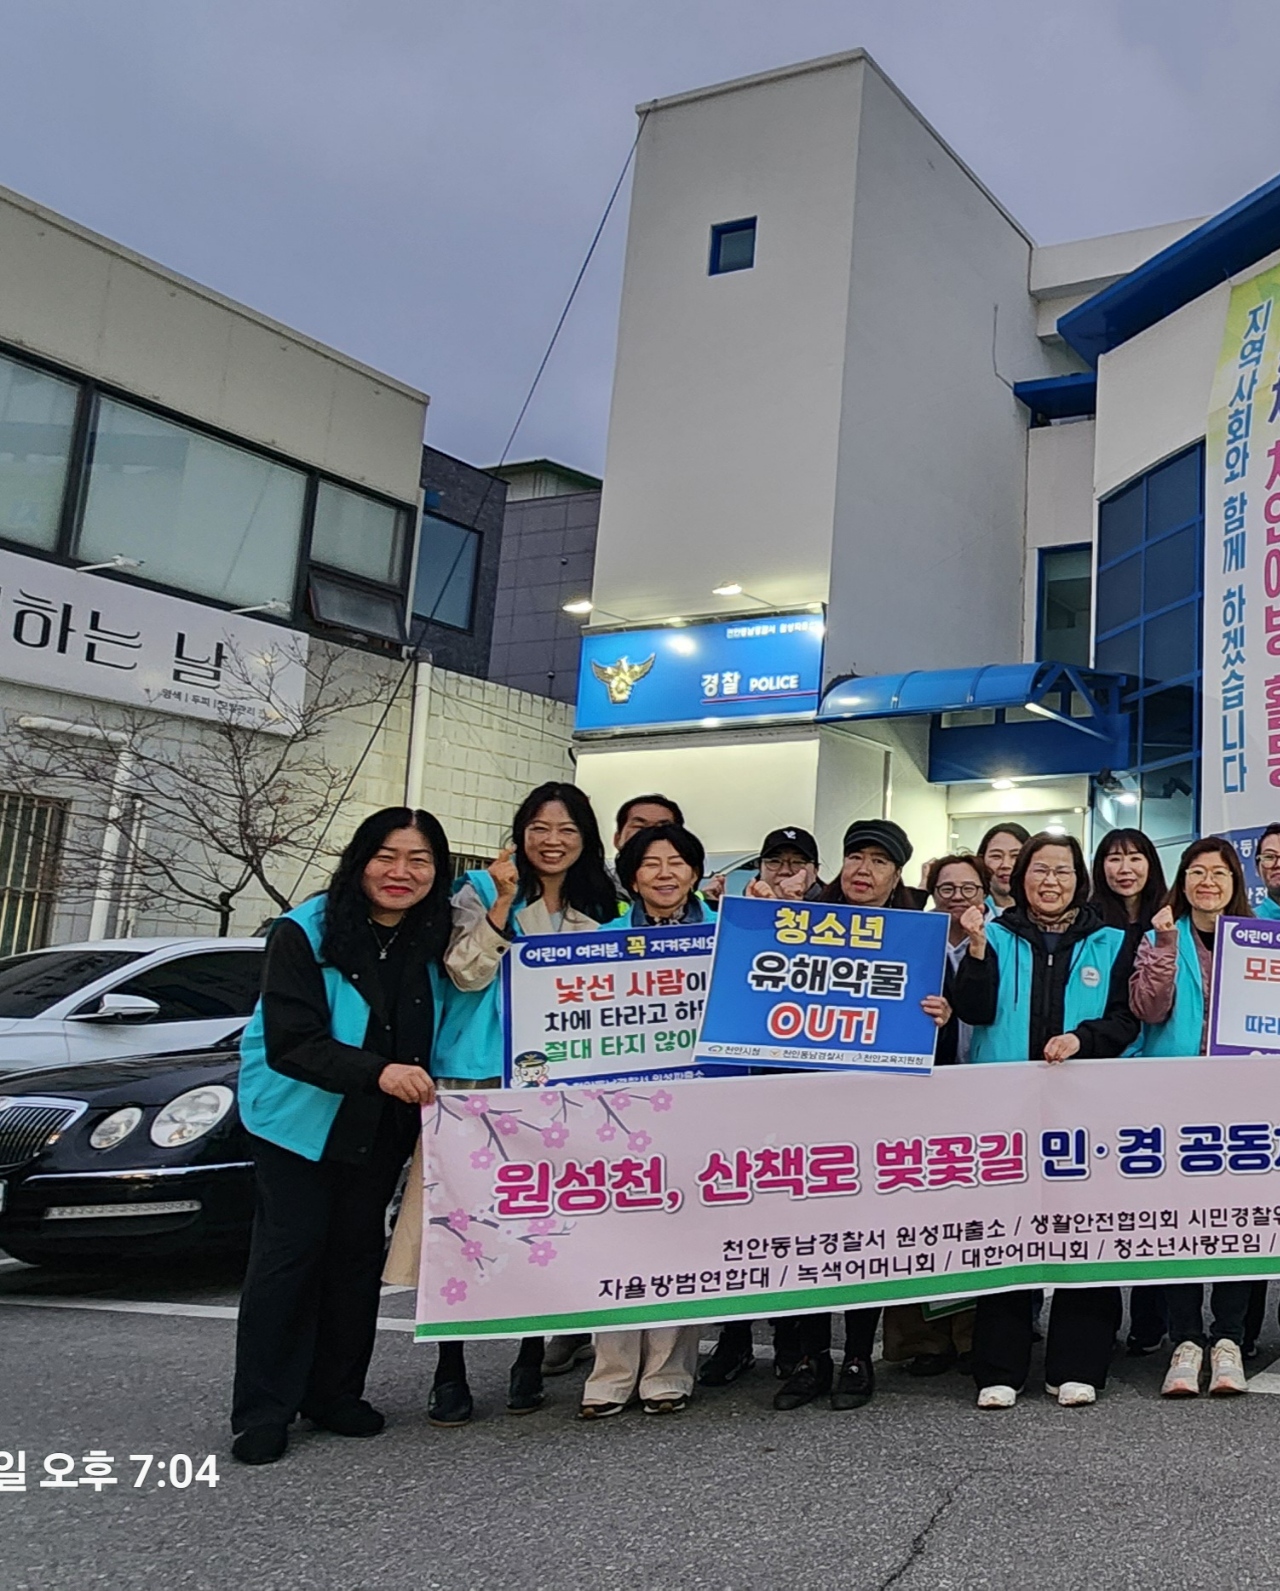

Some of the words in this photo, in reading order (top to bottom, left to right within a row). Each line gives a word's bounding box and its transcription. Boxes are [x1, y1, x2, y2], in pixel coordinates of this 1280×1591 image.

[1224, 299, 1272, 485] 지역사회와
[1222, 491, 1247, 575] 함께
[12, 588, 143, 671] 하는
[172, 631, 229, 690] 날
[701, 671, 740, 697] 경찰
[749, 674, 799, 692] POLICE
[1221, 584, 1247, 794] 하겠습니다
[525, 946, 572, 962] 어린이
[575, 942, 624, 959] 여러분,
[626, 935, 647, 957] 꼭
[775, 906, 885, 950] 청소년
[1235, 929, 1273, 944] 어린이
[555, 973, 616, 1005] 낯선
[626, 968, 707, 998] 사람이
[748, 951, 908, 1000] 유해약물
[544, 1009, 592, 1033] 차에
[600, 1003, 668, 1028] 타라고
[674, 1000, 705, 1021] 하
[767, 1002, 880, 1044] OUT!
[544, 1038, 593, 1063] 절대
[600, 1033, 646, 1056] 타지
[492, 1152, 684, 1219] 원성천,
[696, 1142, 863, 1206] 산책로
[874, 1130, 1028, 1194] 벚꽃길
[722, 1229, 885, 1262] 천안동남경찰서
[896, 1219, 1006, 1249] 원성파출소
[1030, 1209, 1179, 1235] 생활안전협의회
[598, 1267, 770, 1301] 자율방범연합대
[797, 1252, 936, 1285] 녹색어머니회
[961, 1240, 1089, 1269] 대한어머니회
[1113, 1232, 1261, 1259] 청소년사랑모임
